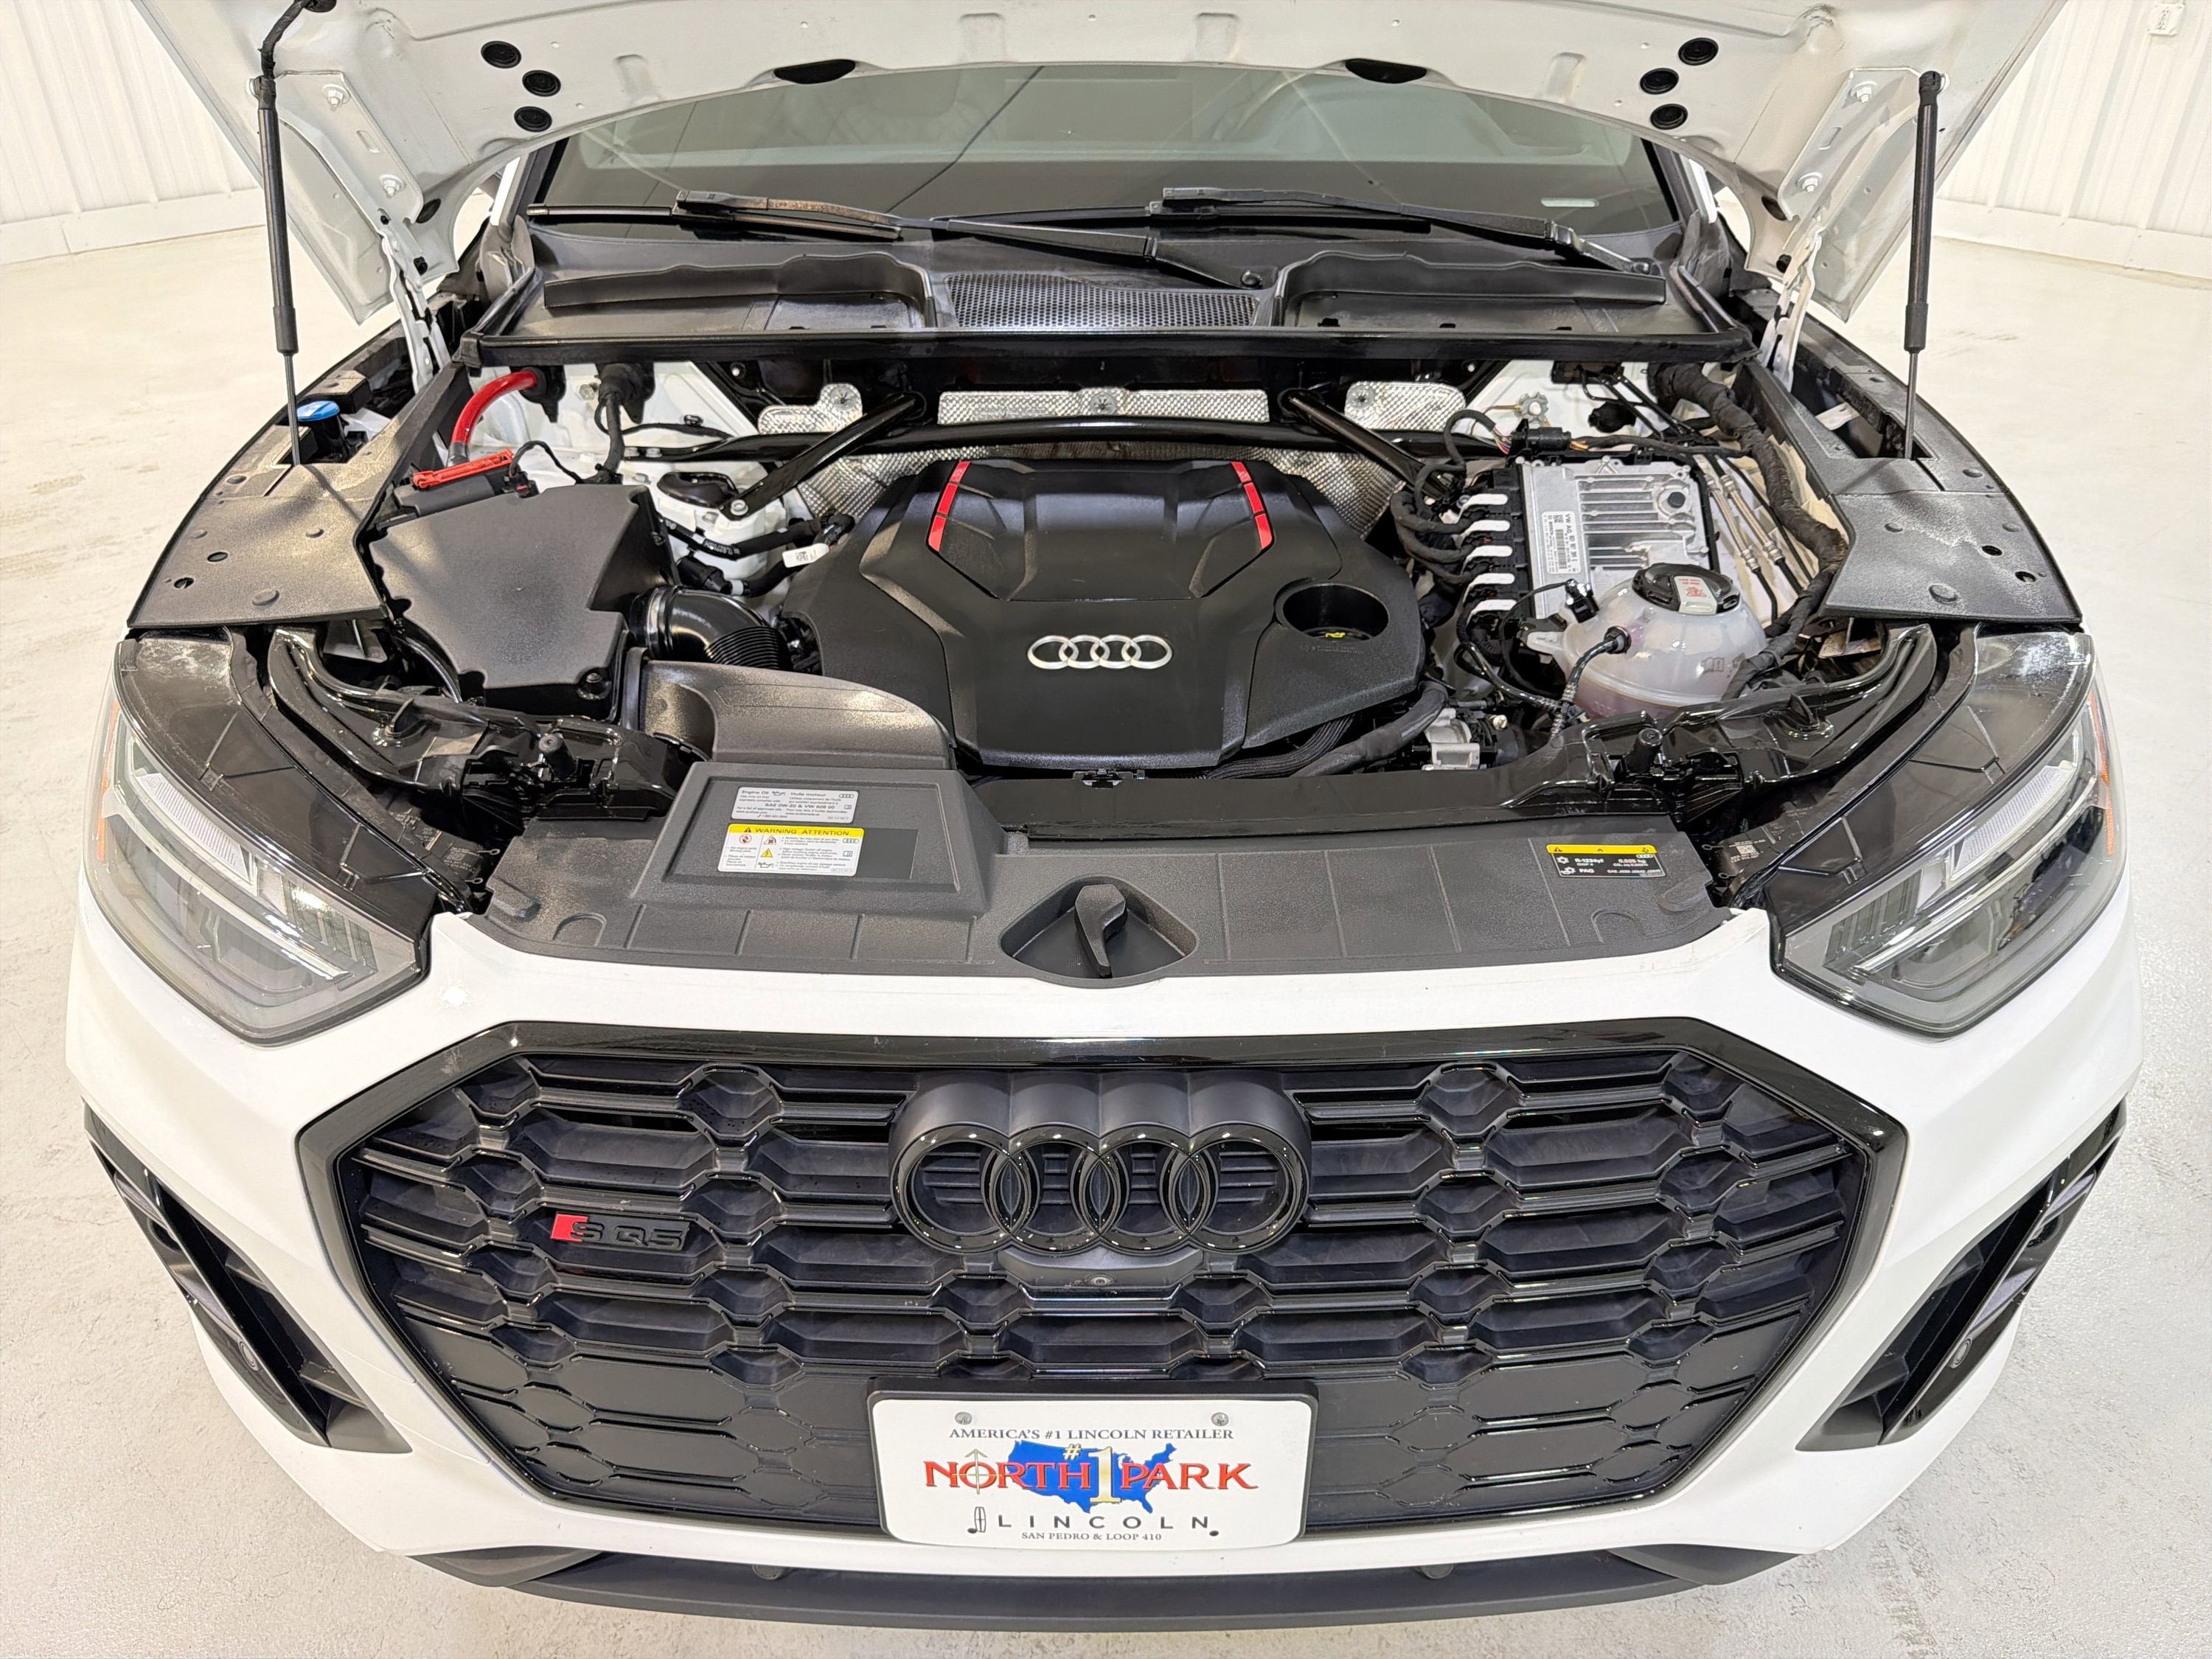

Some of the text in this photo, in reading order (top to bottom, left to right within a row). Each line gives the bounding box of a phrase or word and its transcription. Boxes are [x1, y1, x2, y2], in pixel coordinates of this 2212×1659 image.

[950, 1428, 1234, 1439] AMERICA'S #1 LINCOLN RETAILER
[923, 1460, 1259, 1490] NORTH PARK
[998, 1514, 1209, 1531] LINCOLN
[1021, 1531, 1046, 1540] SAN
[1048, 1532, 1090, 1540] PEDRO
[1093, 1532, 1103, 1541] &
[1106, 1533, 1139, 1541] LOOP
